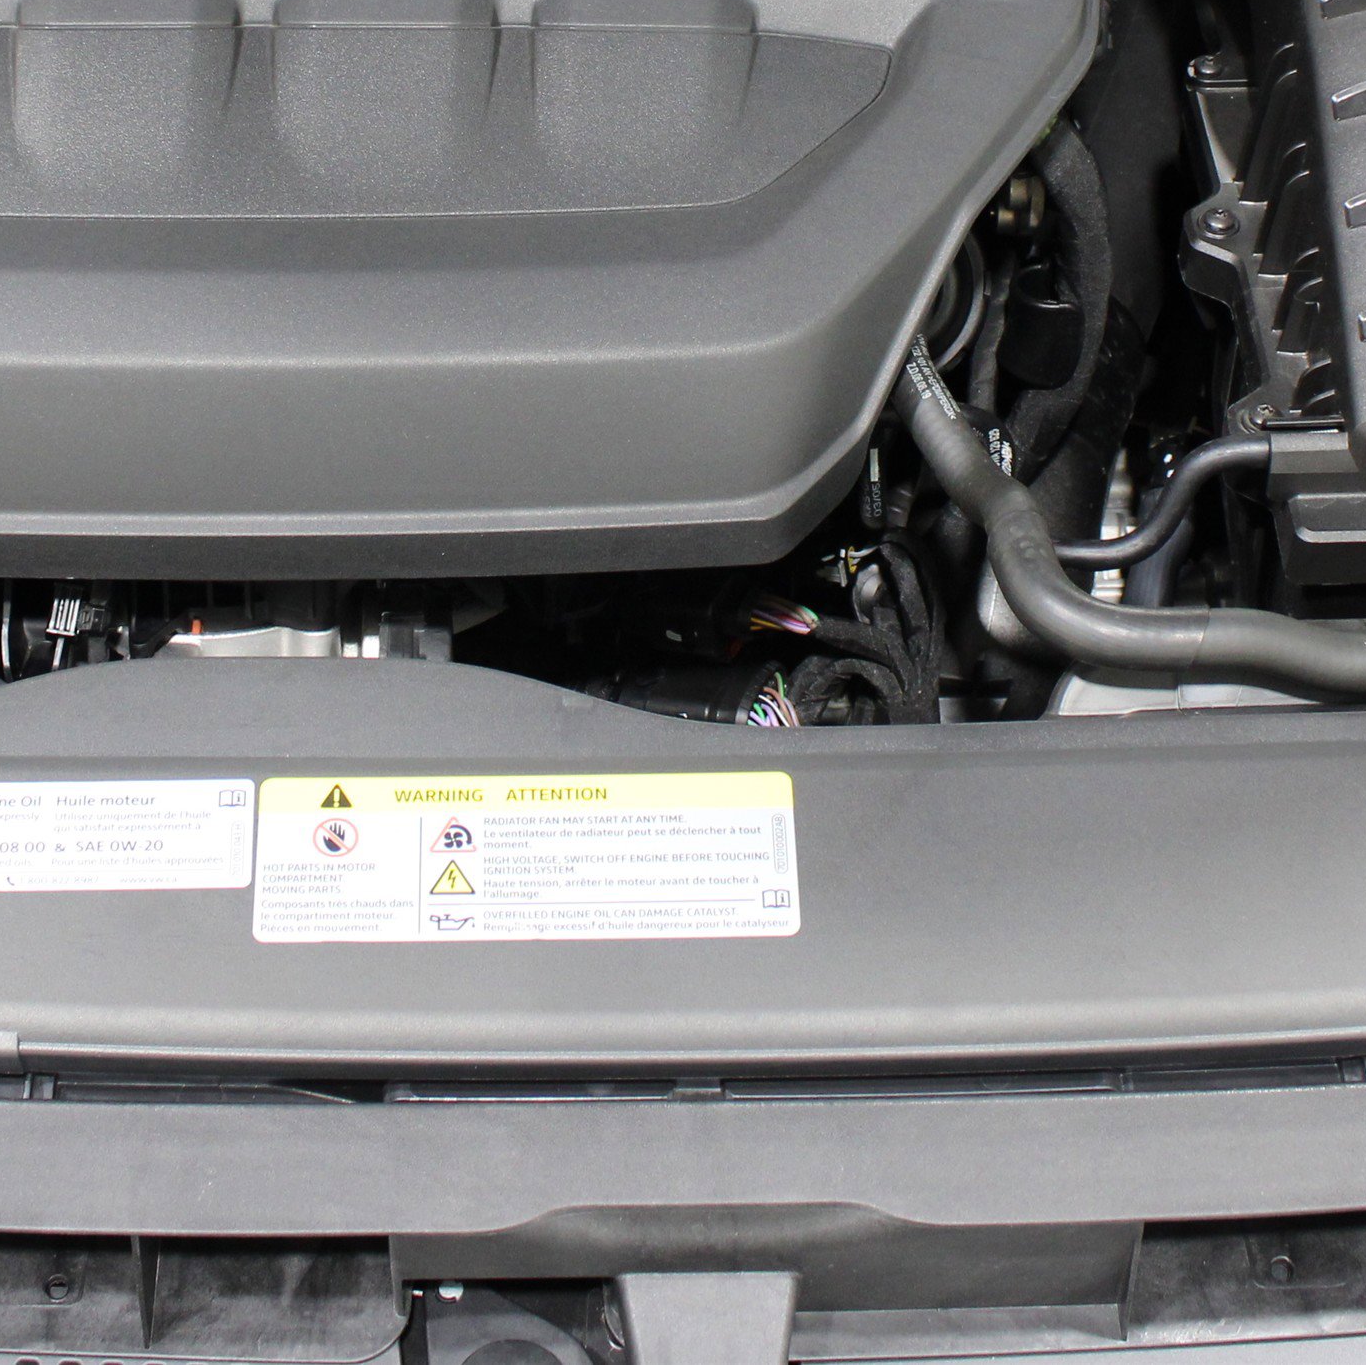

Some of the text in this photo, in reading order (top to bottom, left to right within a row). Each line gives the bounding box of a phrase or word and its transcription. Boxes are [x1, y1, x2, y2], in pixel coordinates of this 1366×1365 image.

[395, 788, 608, 802] WARNING ATTENTION
[21, 796, 41, 807] Oil
[57, 796, 156, 806] Huile moteur
[55, 813, 93, 821] Utilisez
[97, 812, 161, 822] uniquement
[164, 811, 177, 819] de
[483, 817, 536, 826] RADIATOR
[539, 817, 560, 825] FAN
[562, 816, 584, 825] MAY
[587, 815, 619, 824] START
[621, 815, 634, 824] AT
[636, 815, 656, 823] ANY
[53, 825, 70, 834] qui
[74, 823, 115, 831] satisfait
[483, 830, 496, 838] Le
[498, 829, 557, 838] ventilateur
[560, 829, 573, 837] de
[575, 828, 624, 837] radiateur
[627, 828, 652, 838] peut
[669, 825, 727, 836] déclencher
[729, 826, 736, 835] à
[738, 826, 761, 834] tout
[25, 842, 45, 853] 00
[55, 843, 66, 852] &
[76, 841, 104, 852] SAE
[110, 840, 164, 851] 0W-20
[51, 858, 74, 866] Pour
[78, 858, 97, 866] une
[99, 857, 119, 865] liste
[483, 856, 510, 864] HIGH
[564, 855, 603, 863] SWITCH
[607, 854, 626, 862] OFF
[630, 853, 669, 863] ENGINE
[671, 853, 713, 862] BEFORE
[716, 852, 770, 861] TOUCHING
[263, 863, 376, 871] HOT PARTS IN MOTOR
[483, 875, 759, 888] Haute tension, arrêter le moteur avant de toucher à
[262, 886, 305, 894] MOVING
[261, 899, 325, 910] Composants
[350, 899, 386, 907] chauds
[389, 899, 414, 907] dans
[260, 912, 270, 920] le
[273, 912, 351, 921] compartiment
[483, 910, 548, 919] OVERFILLED
[551, 910, 590, 918] ENGINE
[594, 909, 611, 917] OIL
[614, 909, 636, 918] CAN
[638, 908, 683, 917] DAMAGE
[297, 924, 310, 932] en
[554, 921, 595, 930] excessif
[637, 921, 692, 931] dangereux
[695, 920, 720, 929] pour
[723, 920, 732, 928] le
